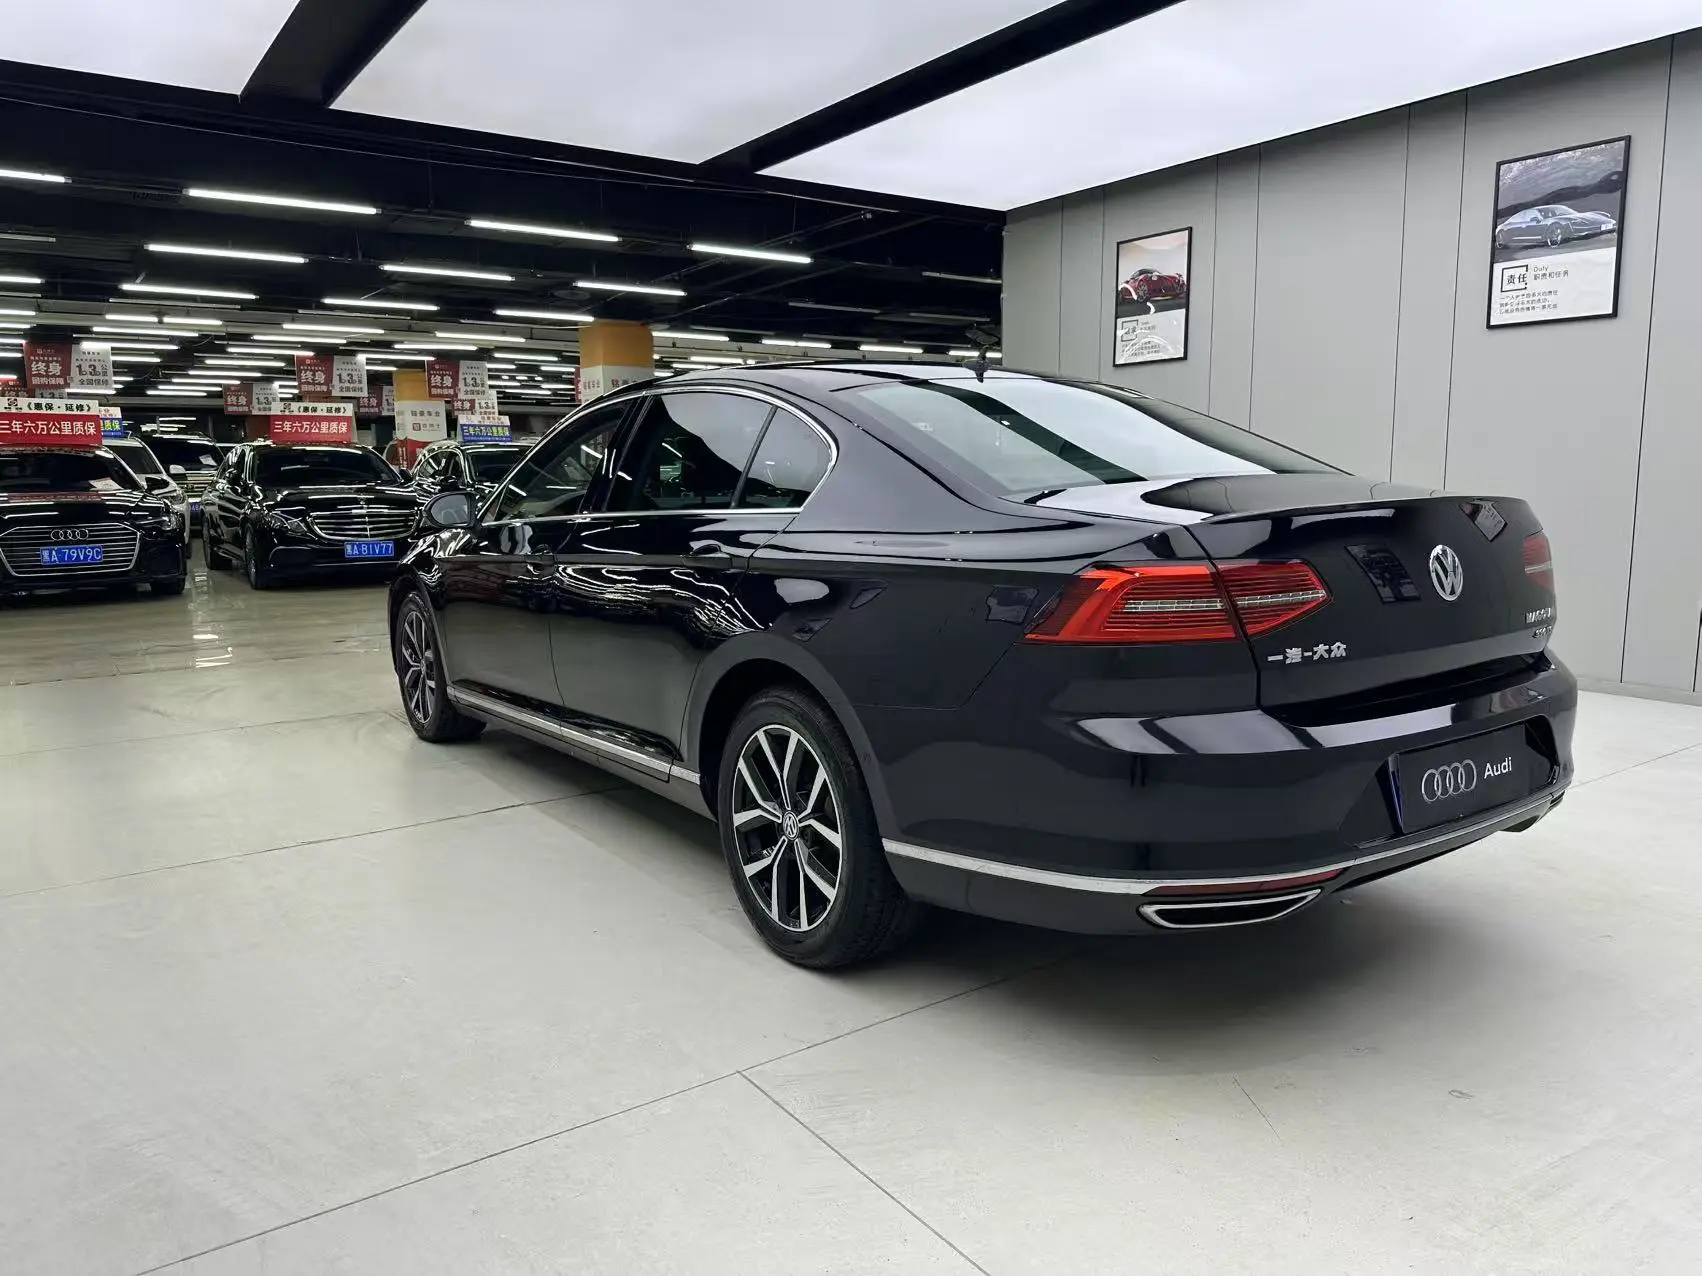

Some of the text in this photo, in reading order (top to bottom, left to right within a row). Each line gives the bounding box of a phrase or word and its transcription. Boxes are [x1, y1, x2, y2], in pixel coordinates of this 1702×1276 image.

[1507, 273, 1527, 285] 责任
[31, 361, 62, 375] 终身
[301, 370, 326, 383] 终身
[430, 374, 453, 387] 终身
[0, 420, 97, 435] 三年六万公里质保
[273, 421, 348, 434] 三年六万公里质保
[1267, 641, 1347, 664] 一汽-大众
[1484, 756, 1512, 779] Audi
